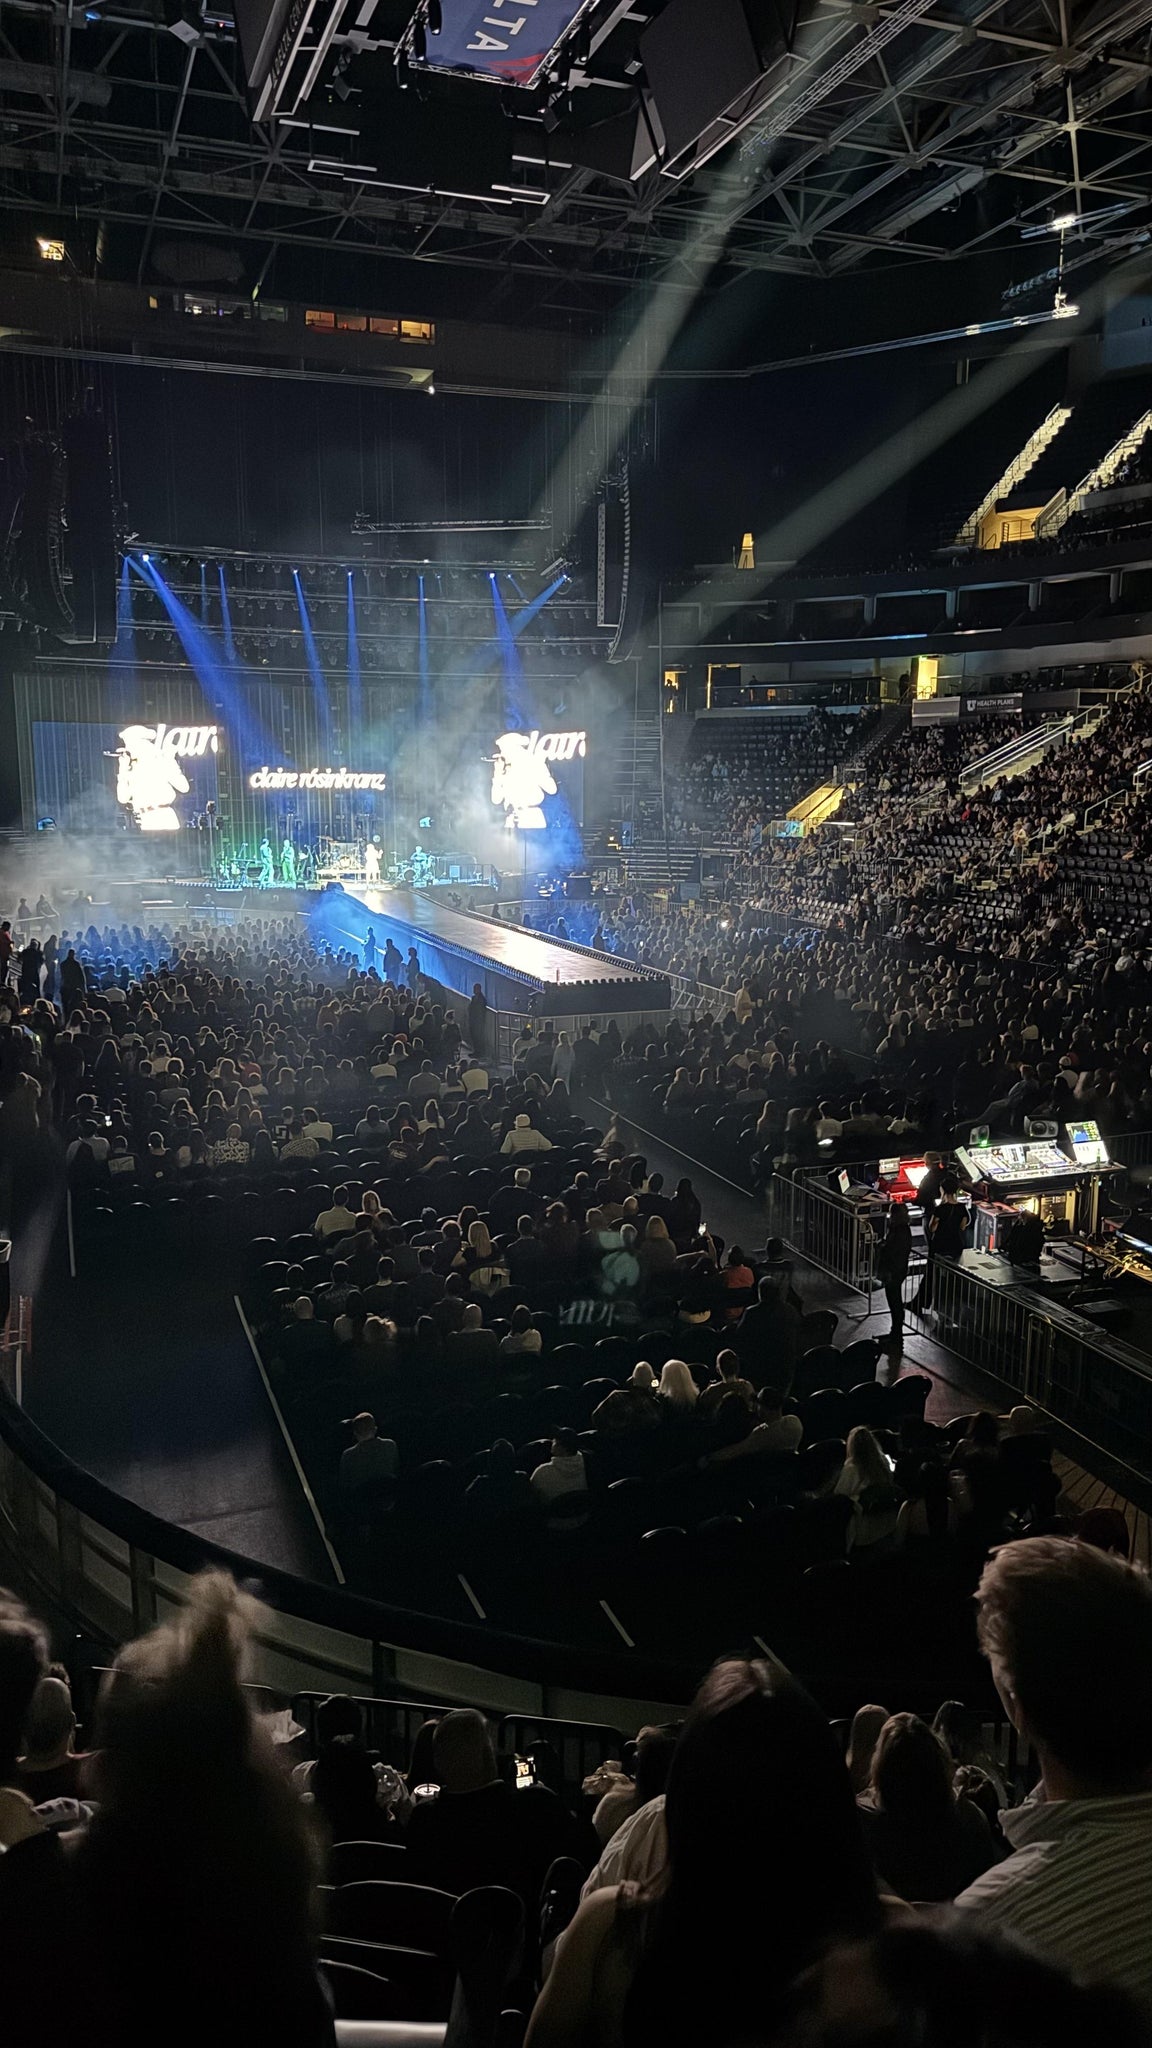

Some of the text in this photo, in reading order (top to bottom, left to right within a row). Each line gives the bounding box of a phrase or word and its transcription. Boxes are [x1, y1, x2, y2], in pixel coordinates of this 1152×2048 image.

[976, 699, 997, 708] HEALTH
[997, 698, 1015, 706] PLANS
[249, 766, 299, 789] claire
